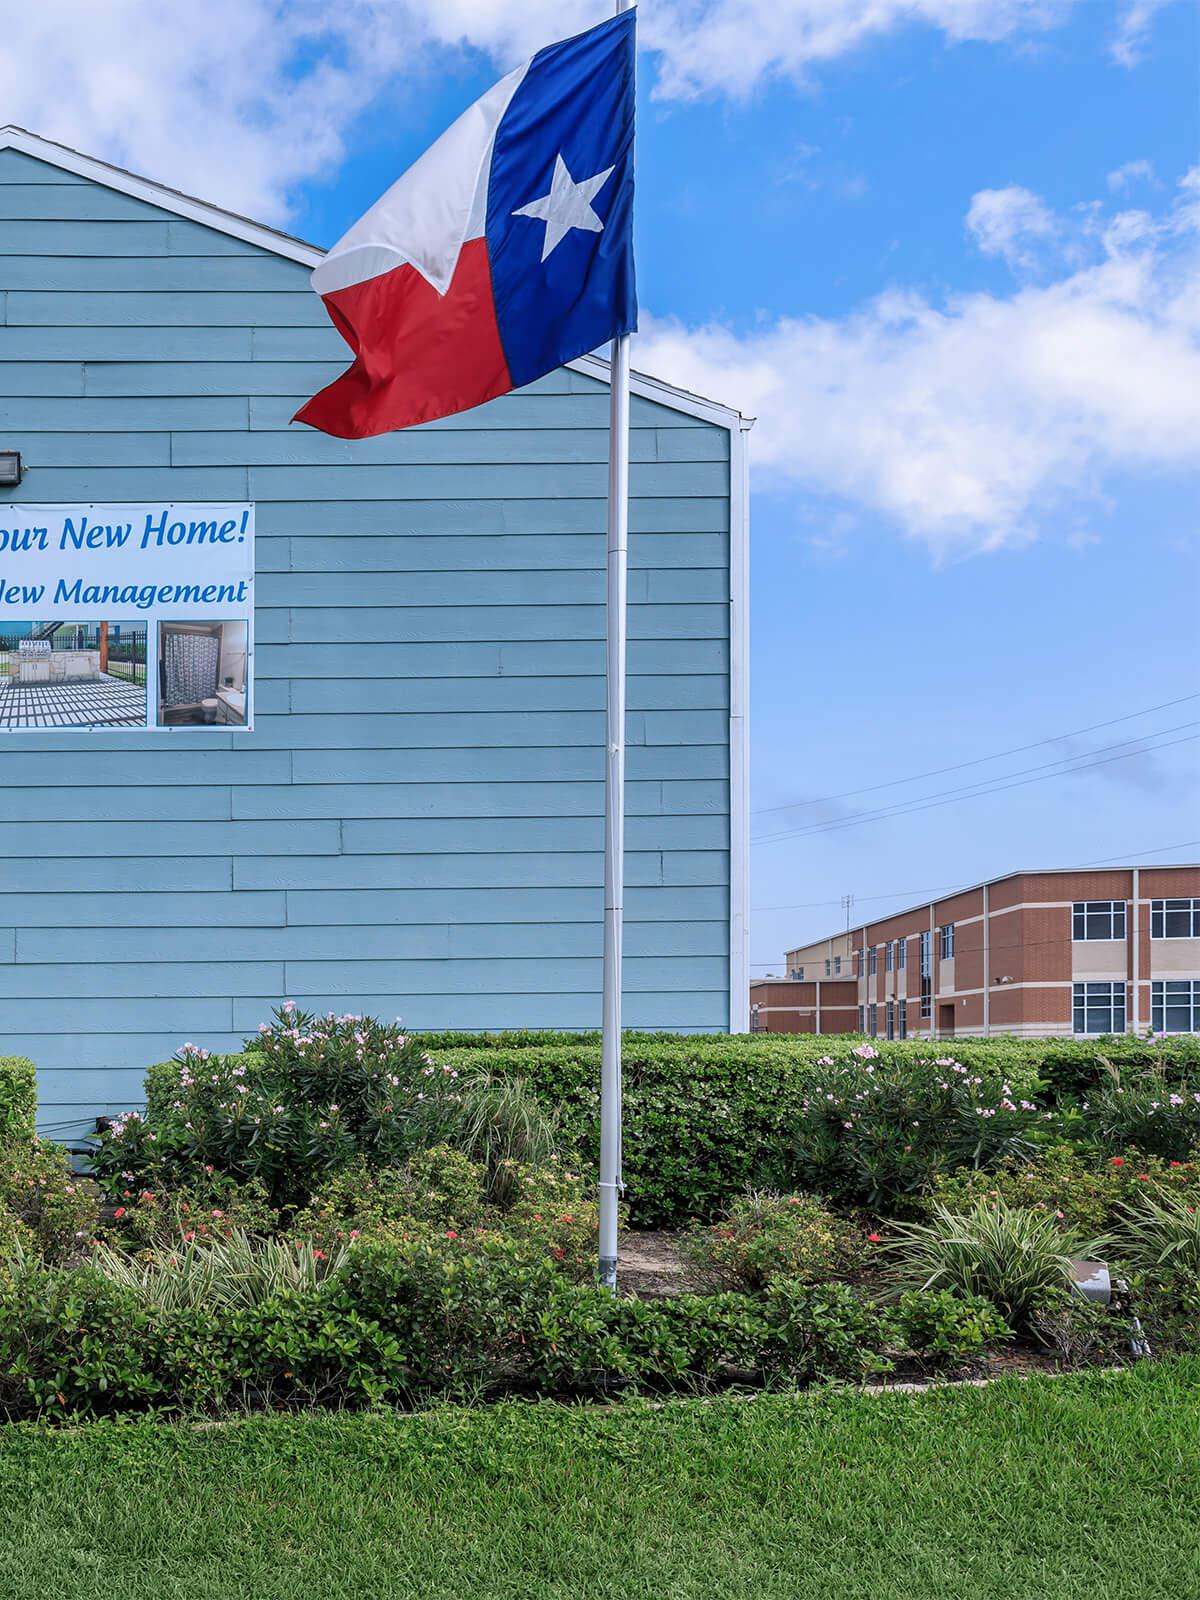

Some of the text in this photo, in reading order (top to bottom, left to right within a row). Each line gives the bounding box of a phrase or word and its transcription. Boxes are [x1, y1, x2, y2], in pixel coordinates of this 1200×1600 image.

[59, 516, 133, 550] New
[140, 510, 250, 549] Home!
[53, 578, 249, 609] Management
